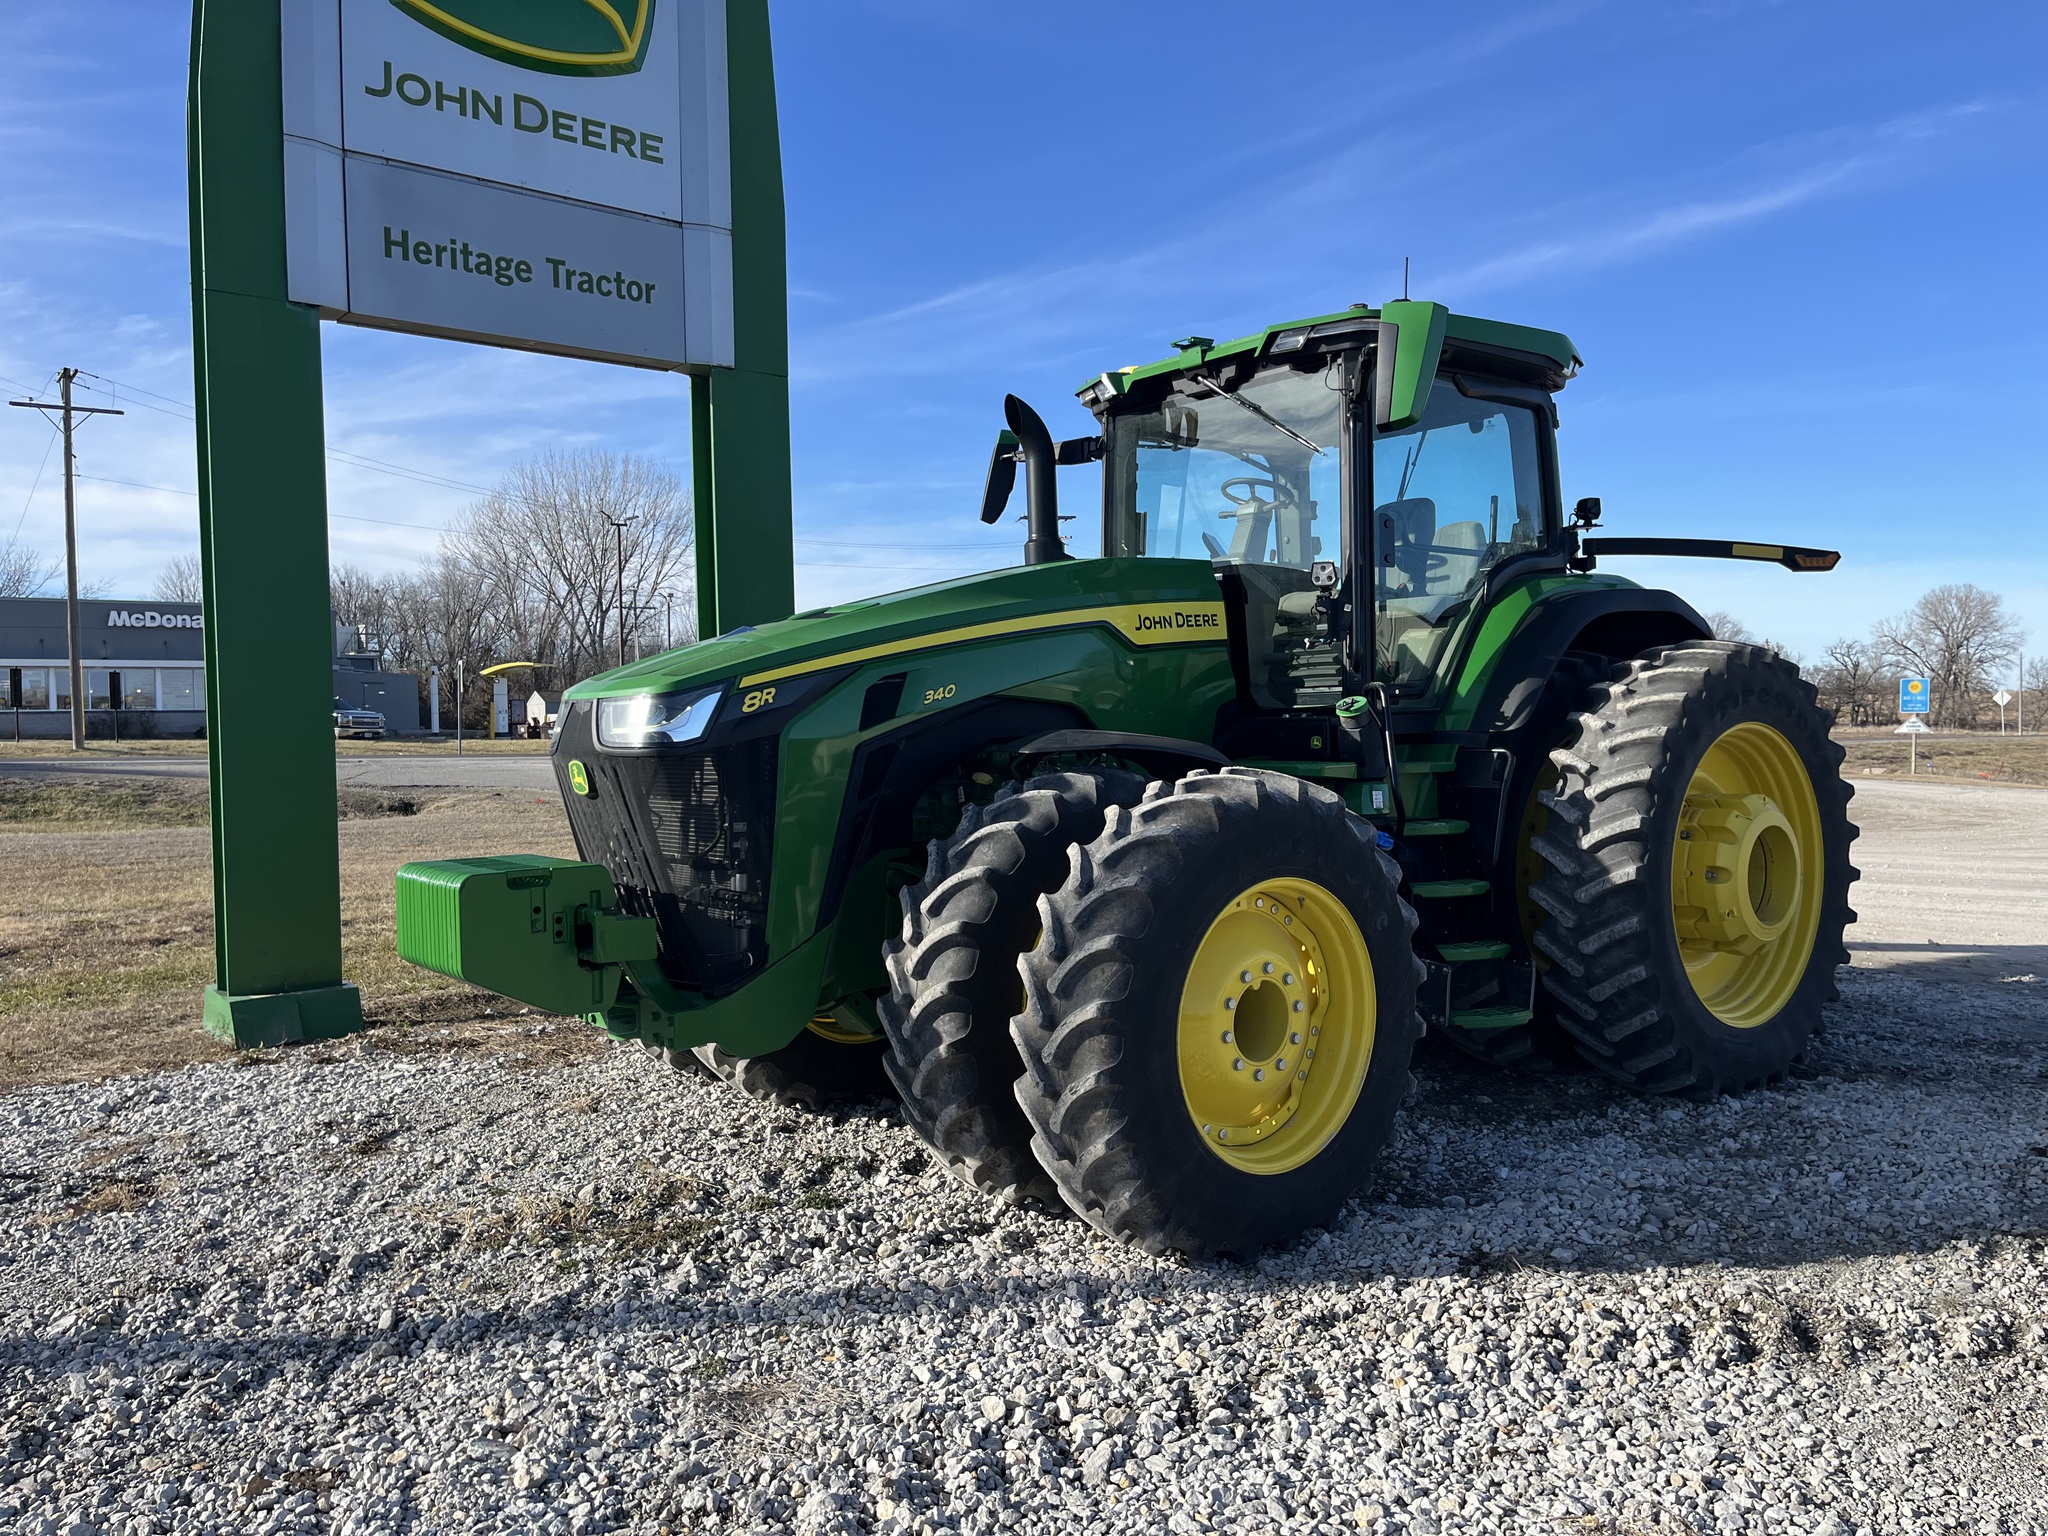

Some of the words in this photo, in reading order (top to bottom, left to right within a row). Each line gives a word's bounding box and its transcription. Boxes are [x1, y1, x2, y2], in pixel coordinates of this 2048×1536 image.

[365, 60, 503, 126] JOHN
[513, 92, 664, 165] DEERE
[383, 225, 533, 287] Heritage
[545, 256, 656, 304] Tractor
[1135, 613, 1173, 631] JOHN
[1174, 612, 1219, 629] DEERE
[741, 687, 776, 713] 8R
[923, 683, 956, 705] 340
